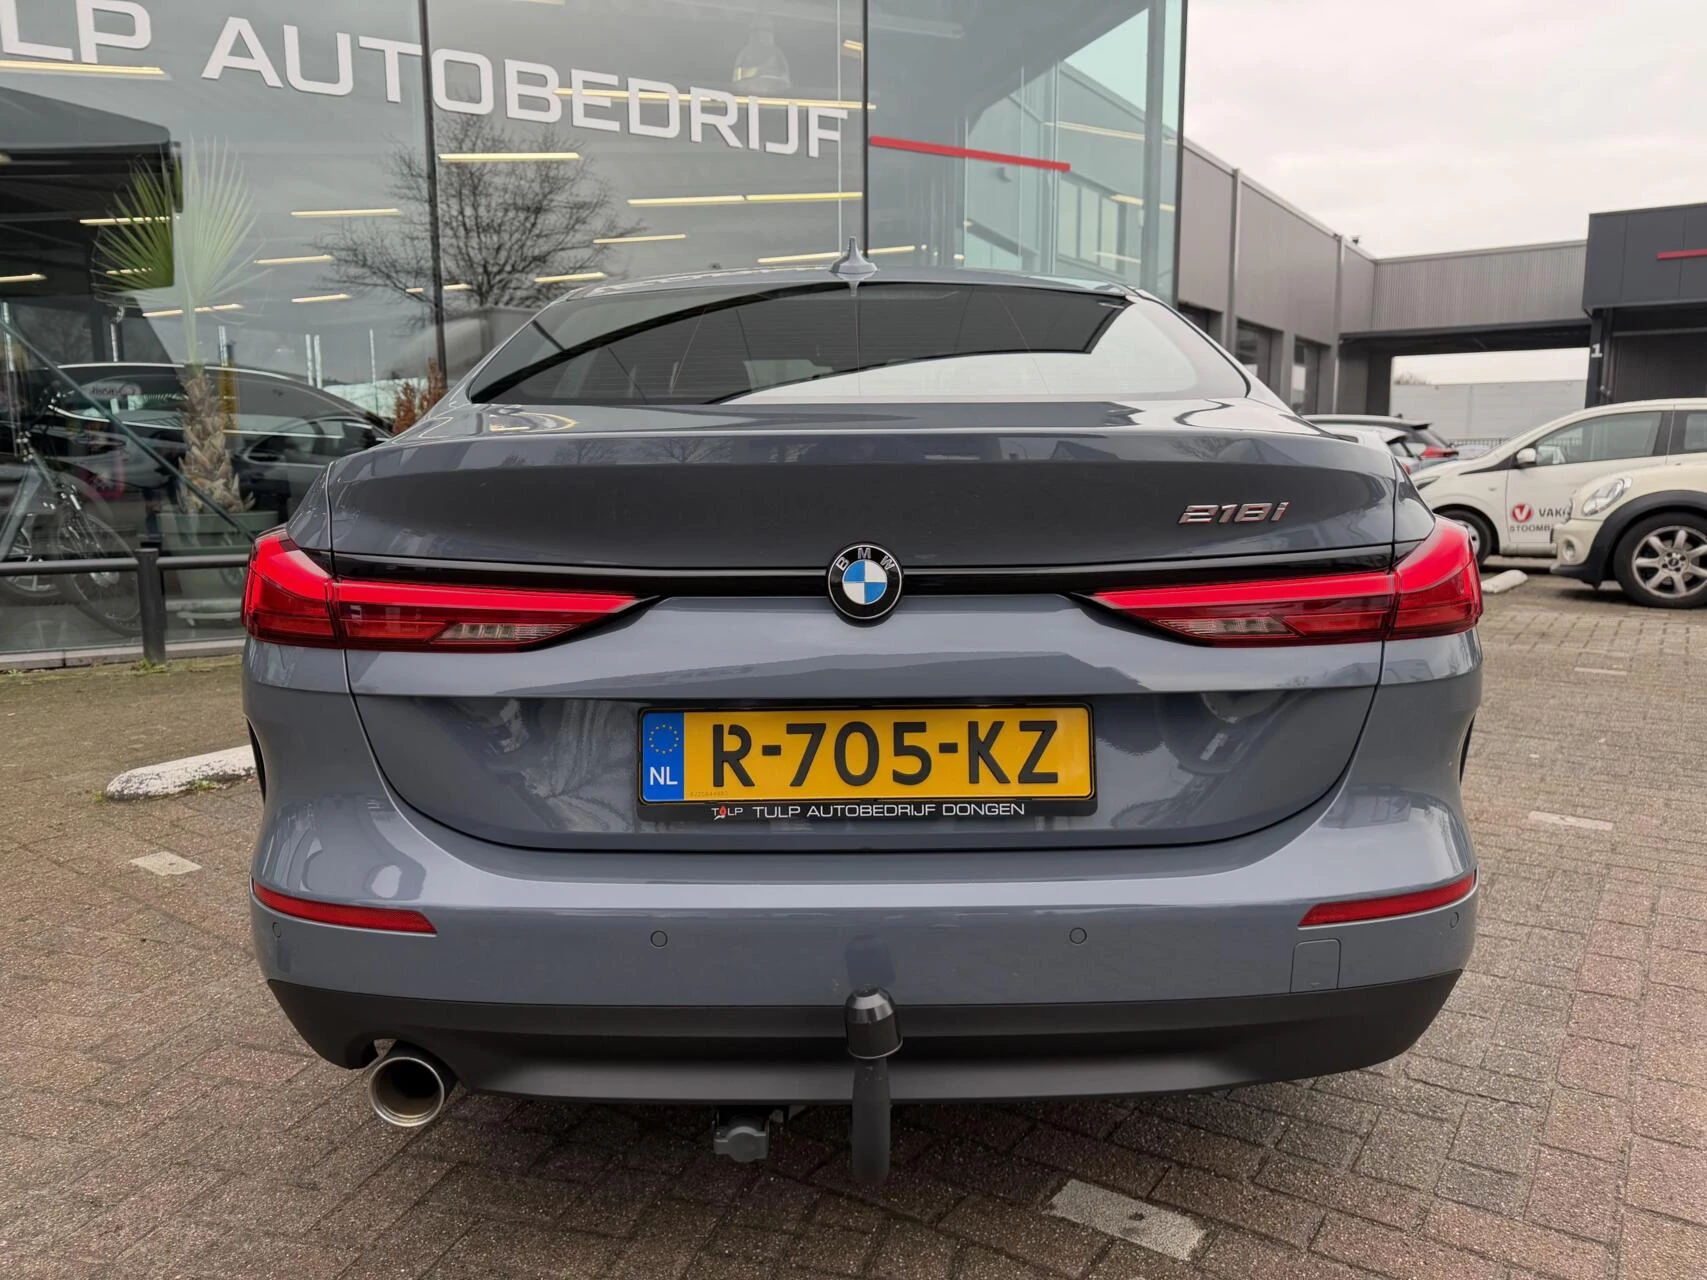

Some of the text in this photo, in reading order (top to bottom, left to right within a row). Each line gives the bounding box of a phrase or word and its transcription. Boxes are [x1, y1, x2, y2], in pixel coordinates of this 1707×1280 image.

[201, 16, 849, 157] AUTOBEDRIJF
[1591, 343, 1603, 358] 1
[1178, 501, 1290, 524] 218i
[835, 547, 896, 572] BMW
[712, 720, 1059, 788] R-705-KZ
[649, 766, 679, 786] NL
[752, 803, 1025, 819] TULP AUTOBEDRIJF DONGEN
